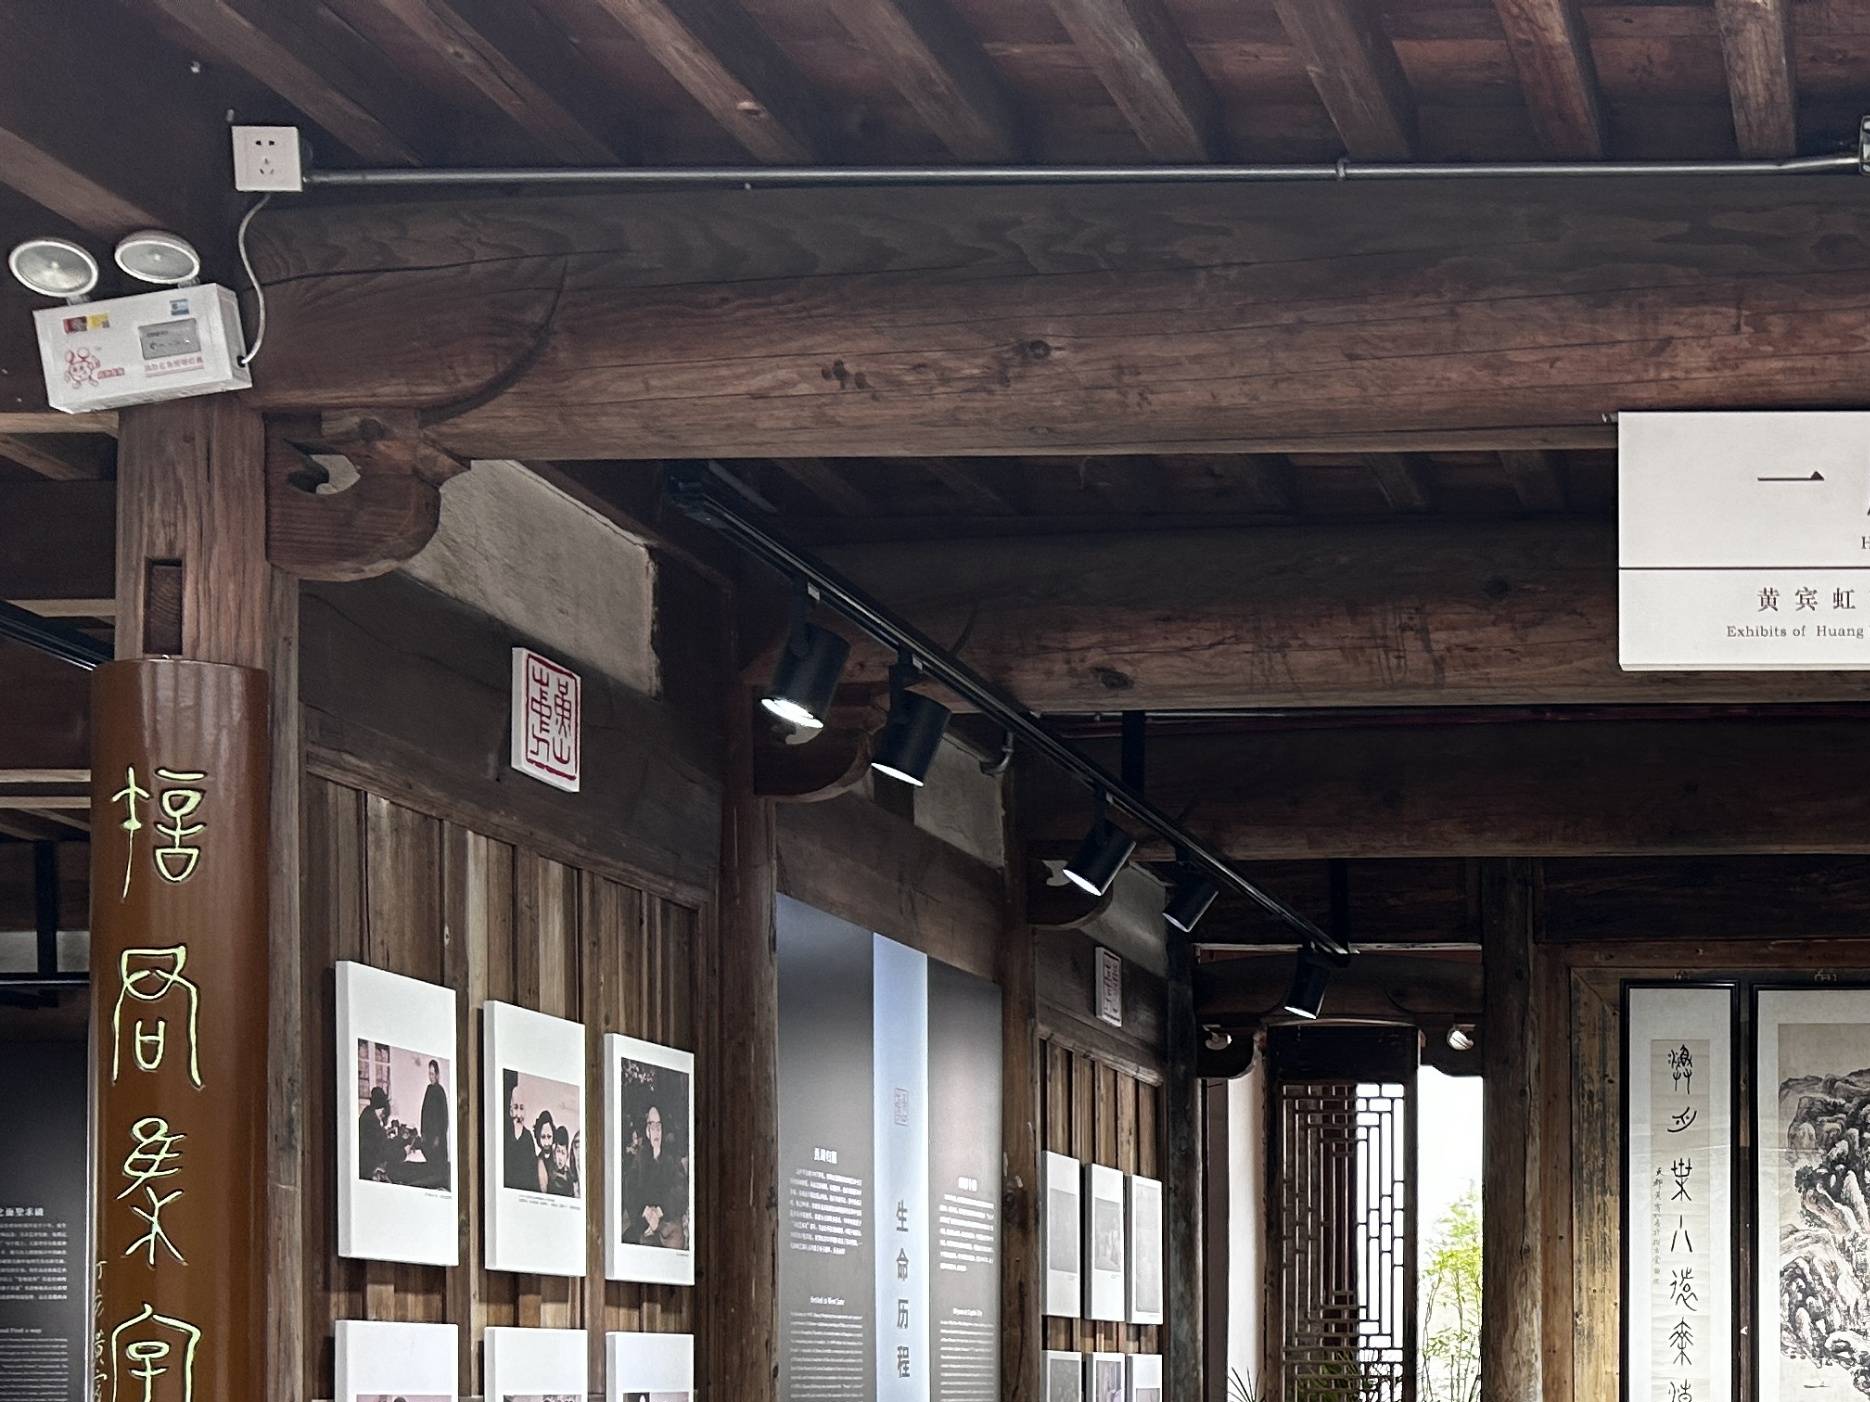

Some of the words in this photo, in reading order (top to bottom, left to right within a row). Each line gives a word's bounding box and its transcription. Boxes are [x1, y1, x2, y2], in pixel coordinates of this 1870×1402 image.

[1726, 625, 1787, 638] Exhibits
[1792, 625, 1807, 638] of
[1816, 625, 1864, 639] Huang
[895, 1199, 911, 1379] 生命历程
